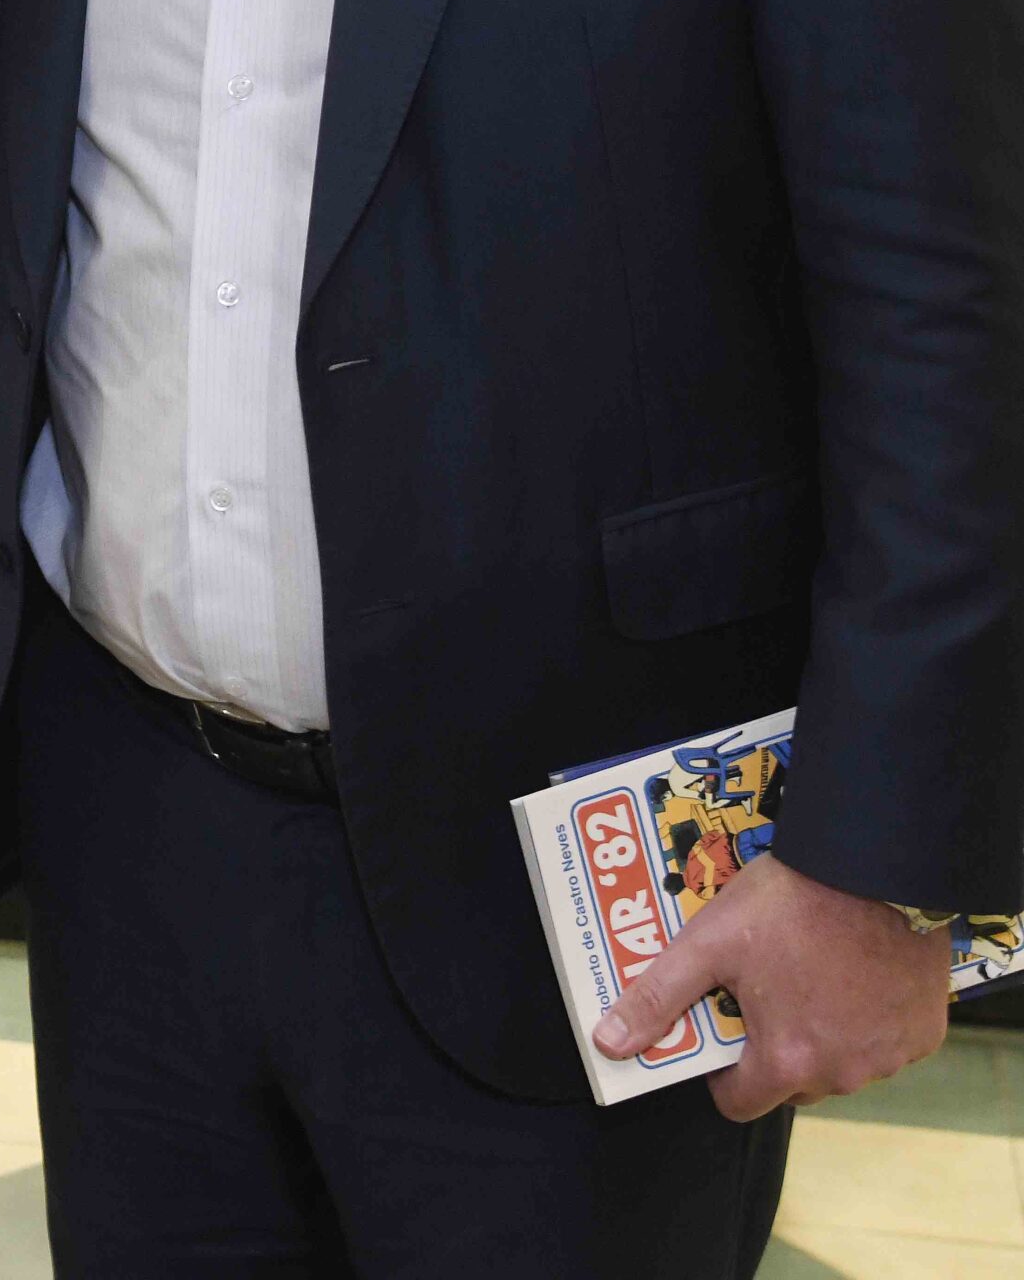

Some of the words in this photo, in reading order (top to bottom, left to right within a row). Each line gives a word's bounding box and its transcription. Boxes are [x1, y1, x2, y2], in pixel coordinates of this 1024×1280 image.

[556, 823, 575, 872] Neves
[585, 803, 637, 887] '82
[568, 875, 589, 927] Castro
[582, 930, 595, 950] de
